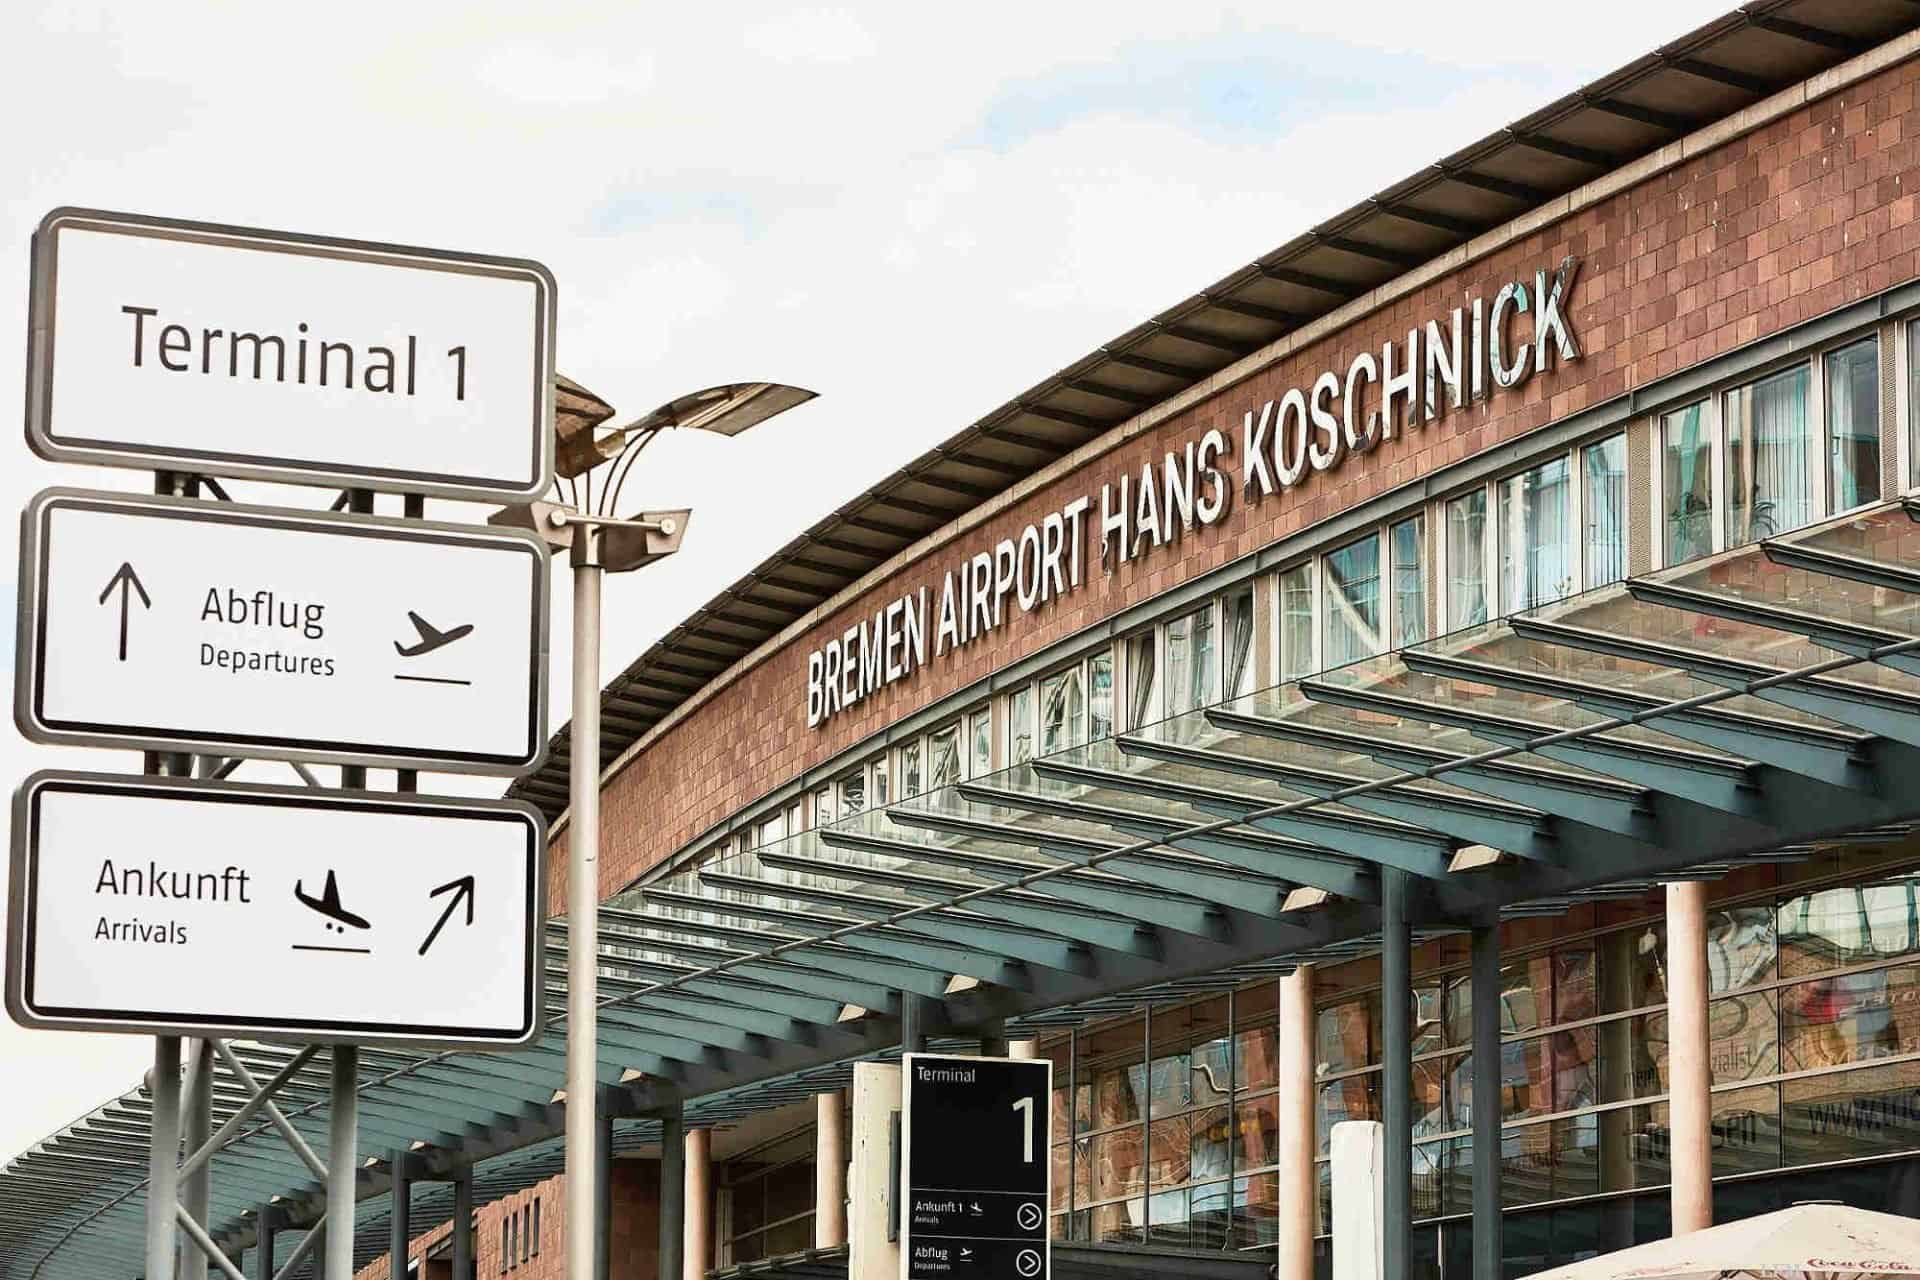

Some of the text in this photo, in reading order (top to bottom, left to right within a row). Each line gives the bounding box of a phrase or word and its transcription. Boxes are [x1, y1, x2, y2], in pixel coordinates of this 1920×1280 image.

[121, 305, 466, 401] Terminal 1
[807, 256, 1580, 730] BREMEN AIRPORT HANS KOSCHNICK
[201, 587, 325, 640] Abflug
[200, 643, 335, 677] Departures
[95, 859, 251, 904] Ankunft
[94, 916, 187, 945] Arrivals
[917, 1066, 976, 1083] Terminal
[1012, 1096, 1034, 1163] 1
[915, 1200, 956, 1213] Ankunft
[914, 1247, 948, 1261] Abflug
